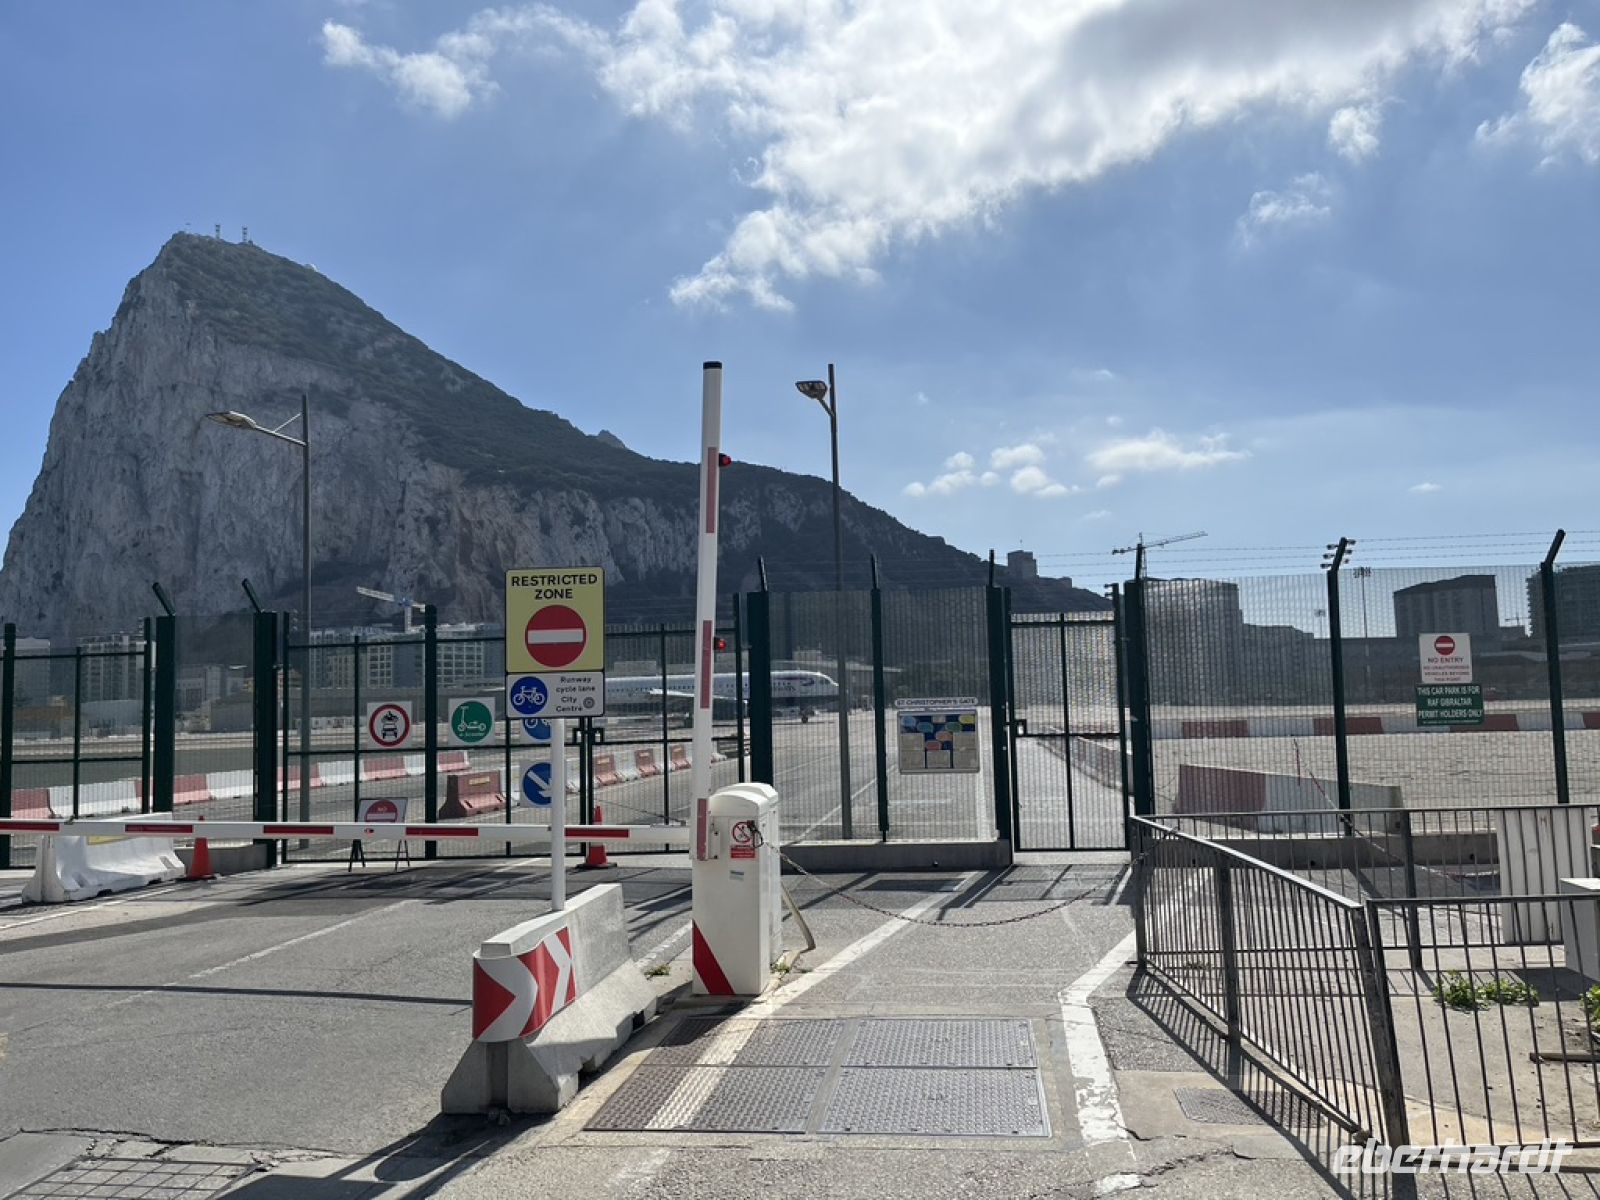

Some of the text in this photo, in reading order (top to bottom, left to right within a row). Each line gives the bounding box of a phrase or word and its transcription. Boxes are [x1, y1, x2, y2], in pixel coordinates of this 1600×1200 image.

[511, 574, 598, 587] RESTRICTED
[534, 588, 573, 600] ZONE
[560, 676, 592, 684] Runway
[1417, 685, 1480, 696] THIS CAR PARK IS FOR
[560, 696, 577, 704] City
[1427, 697, 1472, 707] RAF GIBRALTAR
[1418, 708, 1482, 719] PERMIT HOLDERS ONLY
